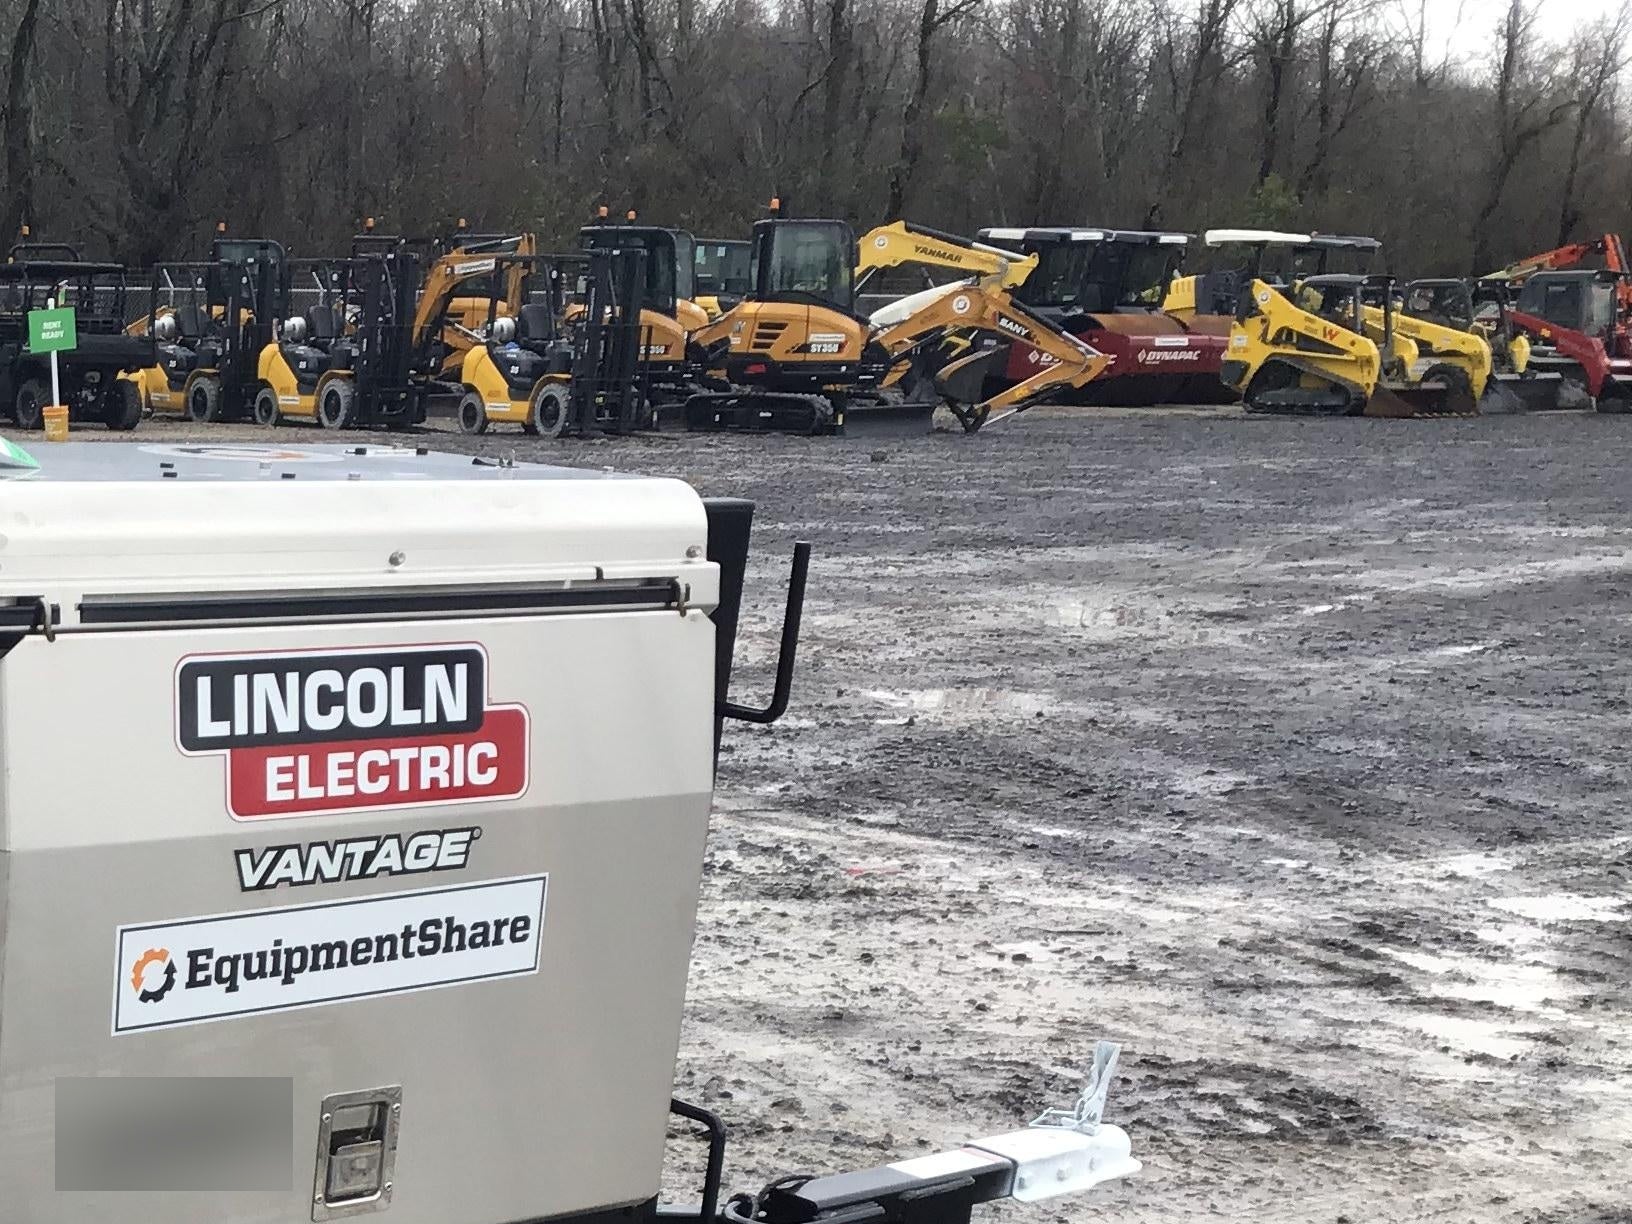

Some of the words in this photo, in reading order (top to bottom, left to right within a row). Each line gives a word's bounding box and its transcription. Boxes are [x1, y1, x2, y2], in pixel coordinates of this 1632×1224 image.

[914, 244, 962, 263] YANMAR
[41, 330, 65, 340] READY
[42, 320, 62, 330] RENT
[999, 316, 1030, 336] SANY
[1146, 349, 1201, 362] DYNAPAC
[196, 663, 468, 738] LINCOLN
[266, 741, 499, 802] ELECTRIC
[235, 828, 473, 891] VANTAGE
[184, 914, 532, 993] EquipmentShare
